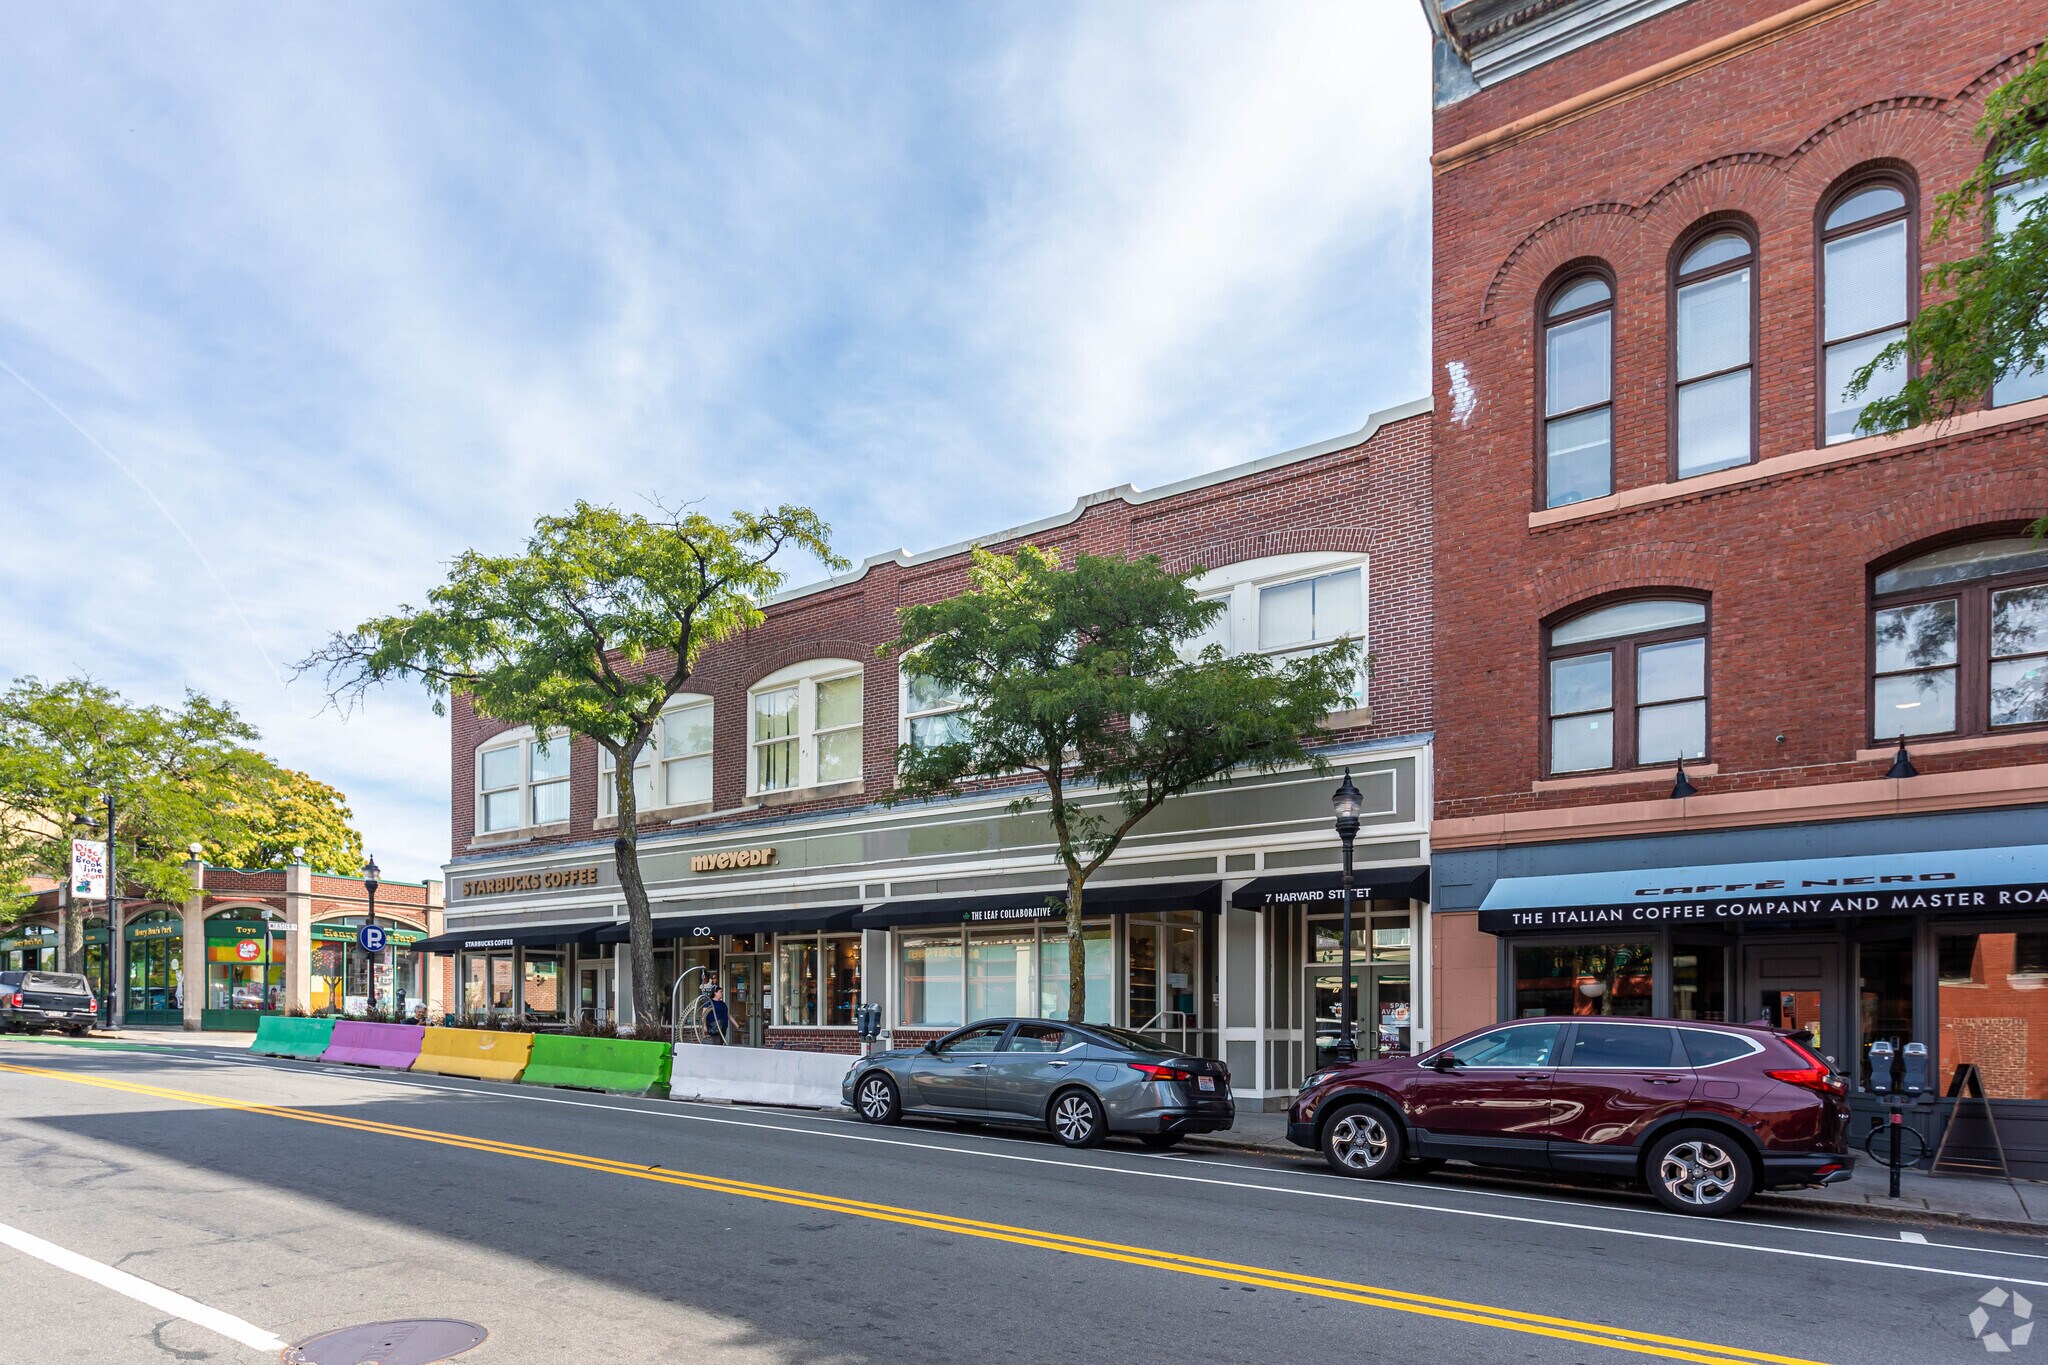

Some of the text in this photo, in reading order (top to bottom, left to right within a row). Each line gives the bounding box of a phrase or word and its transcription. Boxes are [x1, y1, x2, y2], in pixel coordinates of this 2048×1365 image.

[74, 843, 98, 856] Disc
[76, 856, 102, 868] Brook
[80, 852, 102, 862] over
[84, 864, 102, 874] line
[464, 868, 598, 896] STARBUCKS COFFEE
[1802, 872, 1956, 888] NERO
[1265, 888, 1371, 902] 7 HARVARD STET
[972, 907, 1050, 920] THE LEAF COLLABORATIVE
[1512, 912, 1543, 924] THE
[1552, 909, 1622, 923] ITALIAN
[1632, 905, 1705, 920] COFFEE
[1716, 900, 1822, 916] COMPANY
[1830, 897, 1878, 912] AND
[1891, 892, 1985, 909] MASTER
[324, 928, 357, 940] Henry
[393, 933, 416, 944] Park
[367, 928, 382, 948] P
